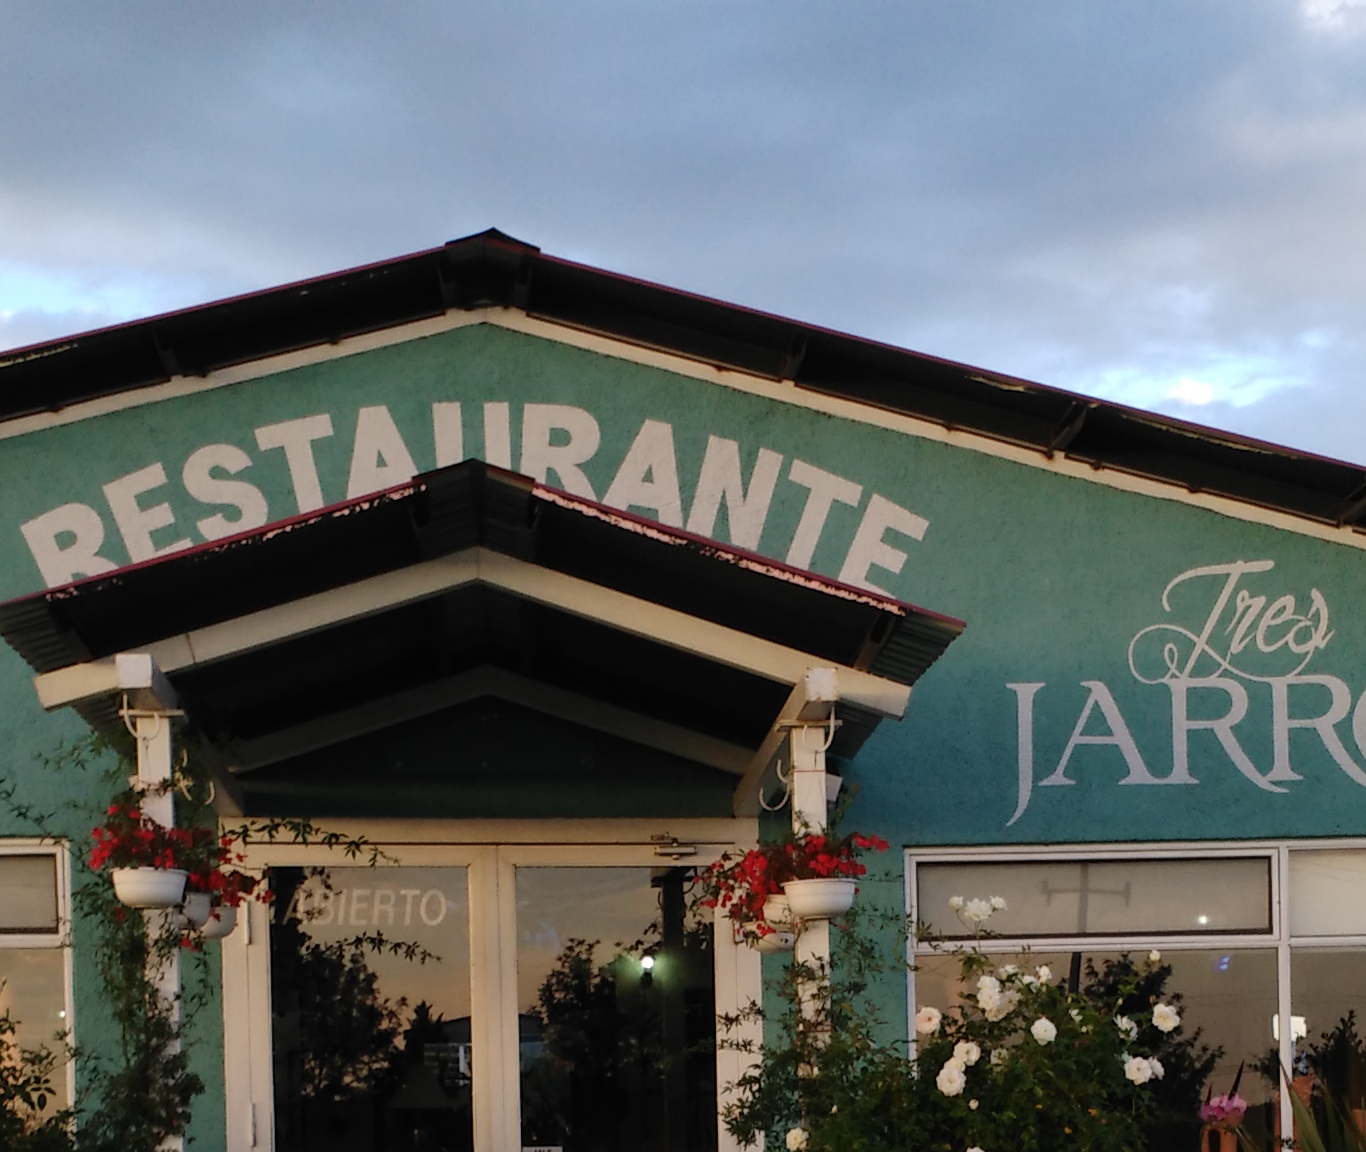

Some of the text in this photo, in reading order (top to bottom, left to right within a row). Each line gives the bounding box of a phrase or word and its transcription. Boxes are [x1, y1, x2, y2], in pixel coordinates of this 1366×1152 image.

[20, 402, 929, 596] RESTAURANTE
[1128, 560, 1336, 685] Tres
[282, 888, 447, 927] ABIERTO
